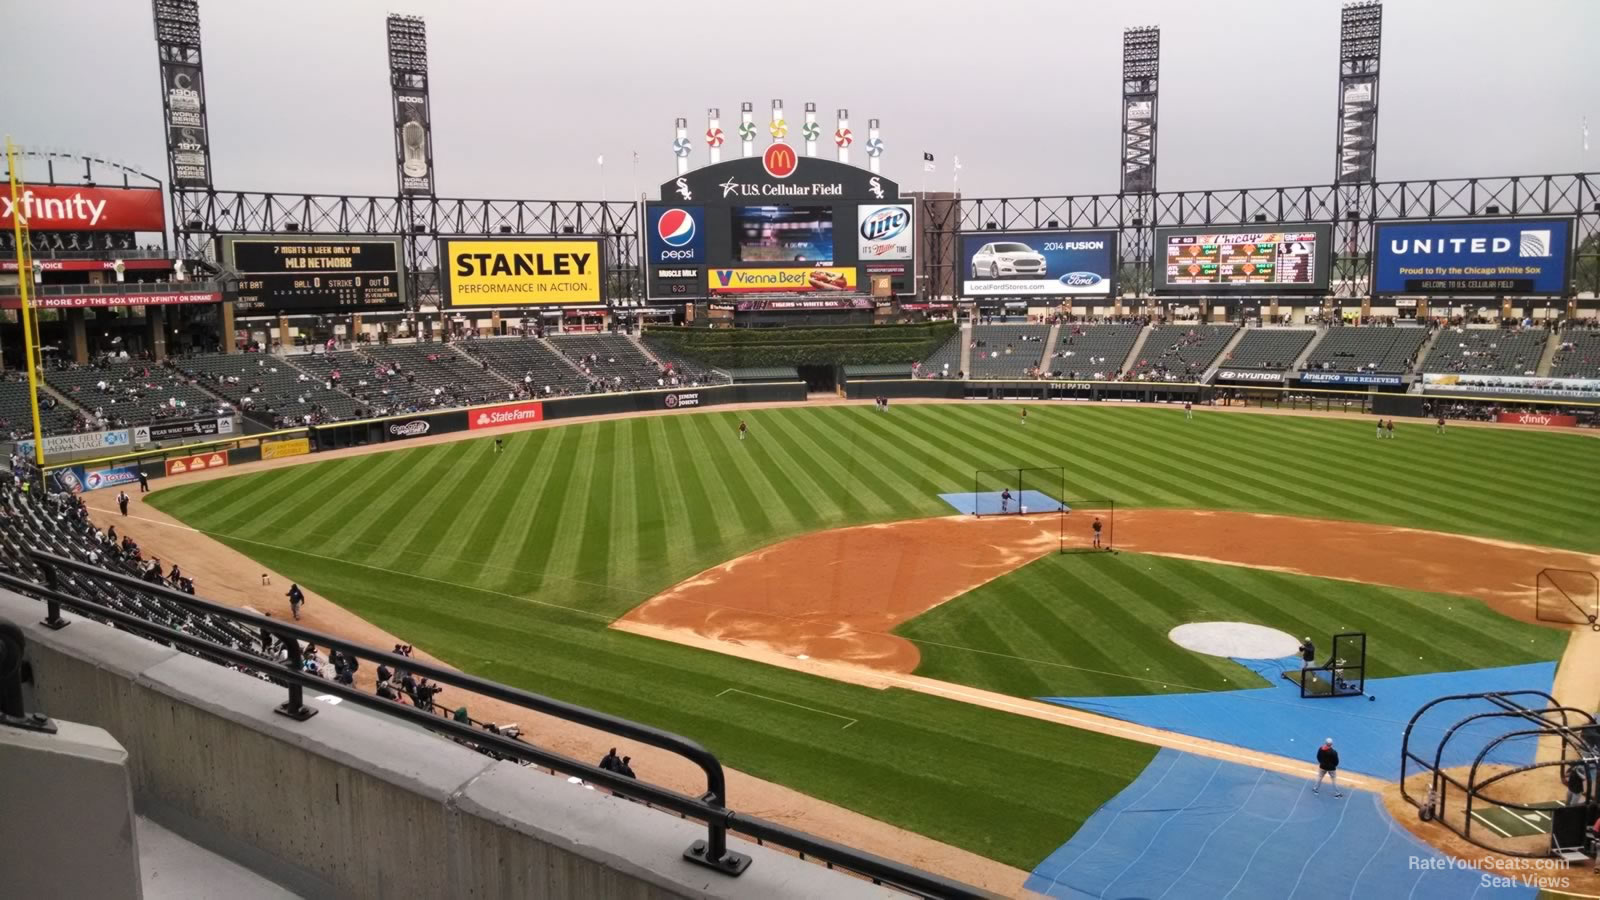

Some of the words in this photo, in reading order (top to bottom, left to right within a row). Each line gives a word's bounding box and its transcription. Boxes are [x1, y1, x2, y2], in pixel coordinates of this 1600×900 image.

[169, 89, 198, 98] 1906
[399, 96, 424, 104] 2005
[177, 142, 201, 151] 1917
[742, 184, 761, 196] U.S.
[762, 184, 810, 196] Cellular
[812, 184, 843, 196] Field
[1043, 242, 1065, 251] 2014
[1065, 241, 1104, 250] FUSION
[1391, 238, 1512, 255] UNITED
[661, 249, 694, 261] pepsi
[285, 257, 307, 269] MLB
[307, 257, 352, 268] NETWORK
[456, 253, 591, 277] STANLEY
[658, 270, 682, 278] MUSCLE
[682, 269, 697, 277] MILK
[1399, 267, 1424, 275] Proud
[1435, 267, 1447, 276] fly
[1463, 266, 1496, 275] Chicago
[1497, 266, 1524, 274] White
[1525, 266, 1541, 274] Sox
[368, 278, 382, 288] OUT
[736, 271, 777, 283] Vienna
[779, 271, 807, 286] Beef
[1067, 272, 1093, 285] Ford
[294, 279, 311, 289] BALL
[329, 279, 353, 289] STRIKE
[458, 283, 534, 293] PERFORMANCE
[537, 283, 548, 291] IN
[970, 283, 1045, 291] LocalFordStores.com
[1497, 280, 1515, 288] FIELD
[46, 298, 72, 306] MORE
[1303, 372, 1341, 380] ATHLETICO
[1359, 376, 1399, 384] RELIEVERS
[678, 399, 699, 407] JOHN'S
[1519, 415, 1551, 425] xfinity
[47, 437, 76, 446] HOME
[79, 433, 102, 443] FIELD
[48, 441, 102, 453] ADVANTAGE
[104, 472, 135, 481] TOTAL
